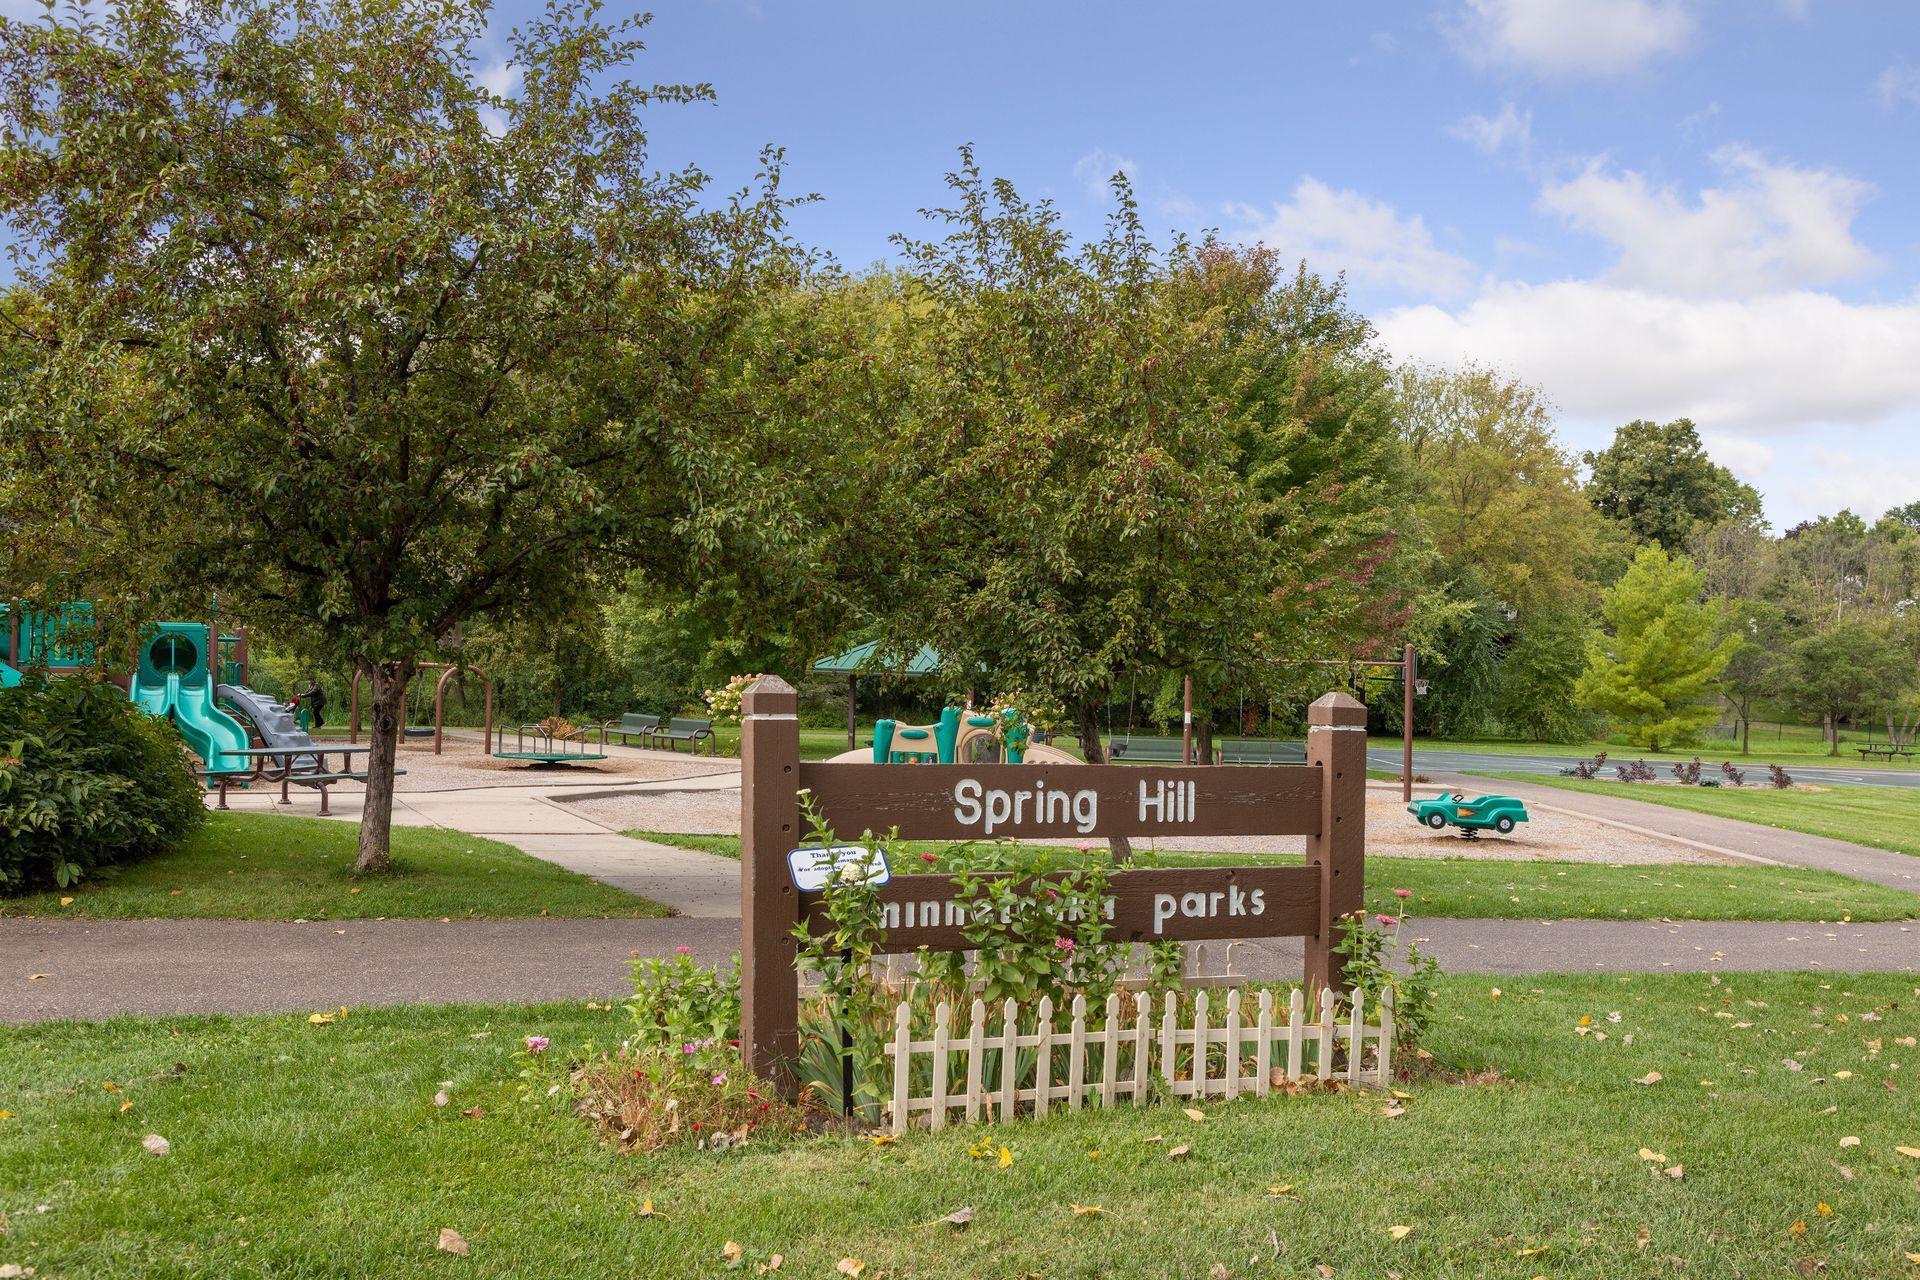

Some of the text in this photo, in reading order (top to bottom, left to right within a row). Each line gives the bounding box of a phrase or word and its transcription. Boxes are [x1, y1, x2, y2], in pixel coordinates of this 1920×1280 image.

[954, 778, 1196, 835] Spring Hill
[1154, 884, 1265, 935] parks
